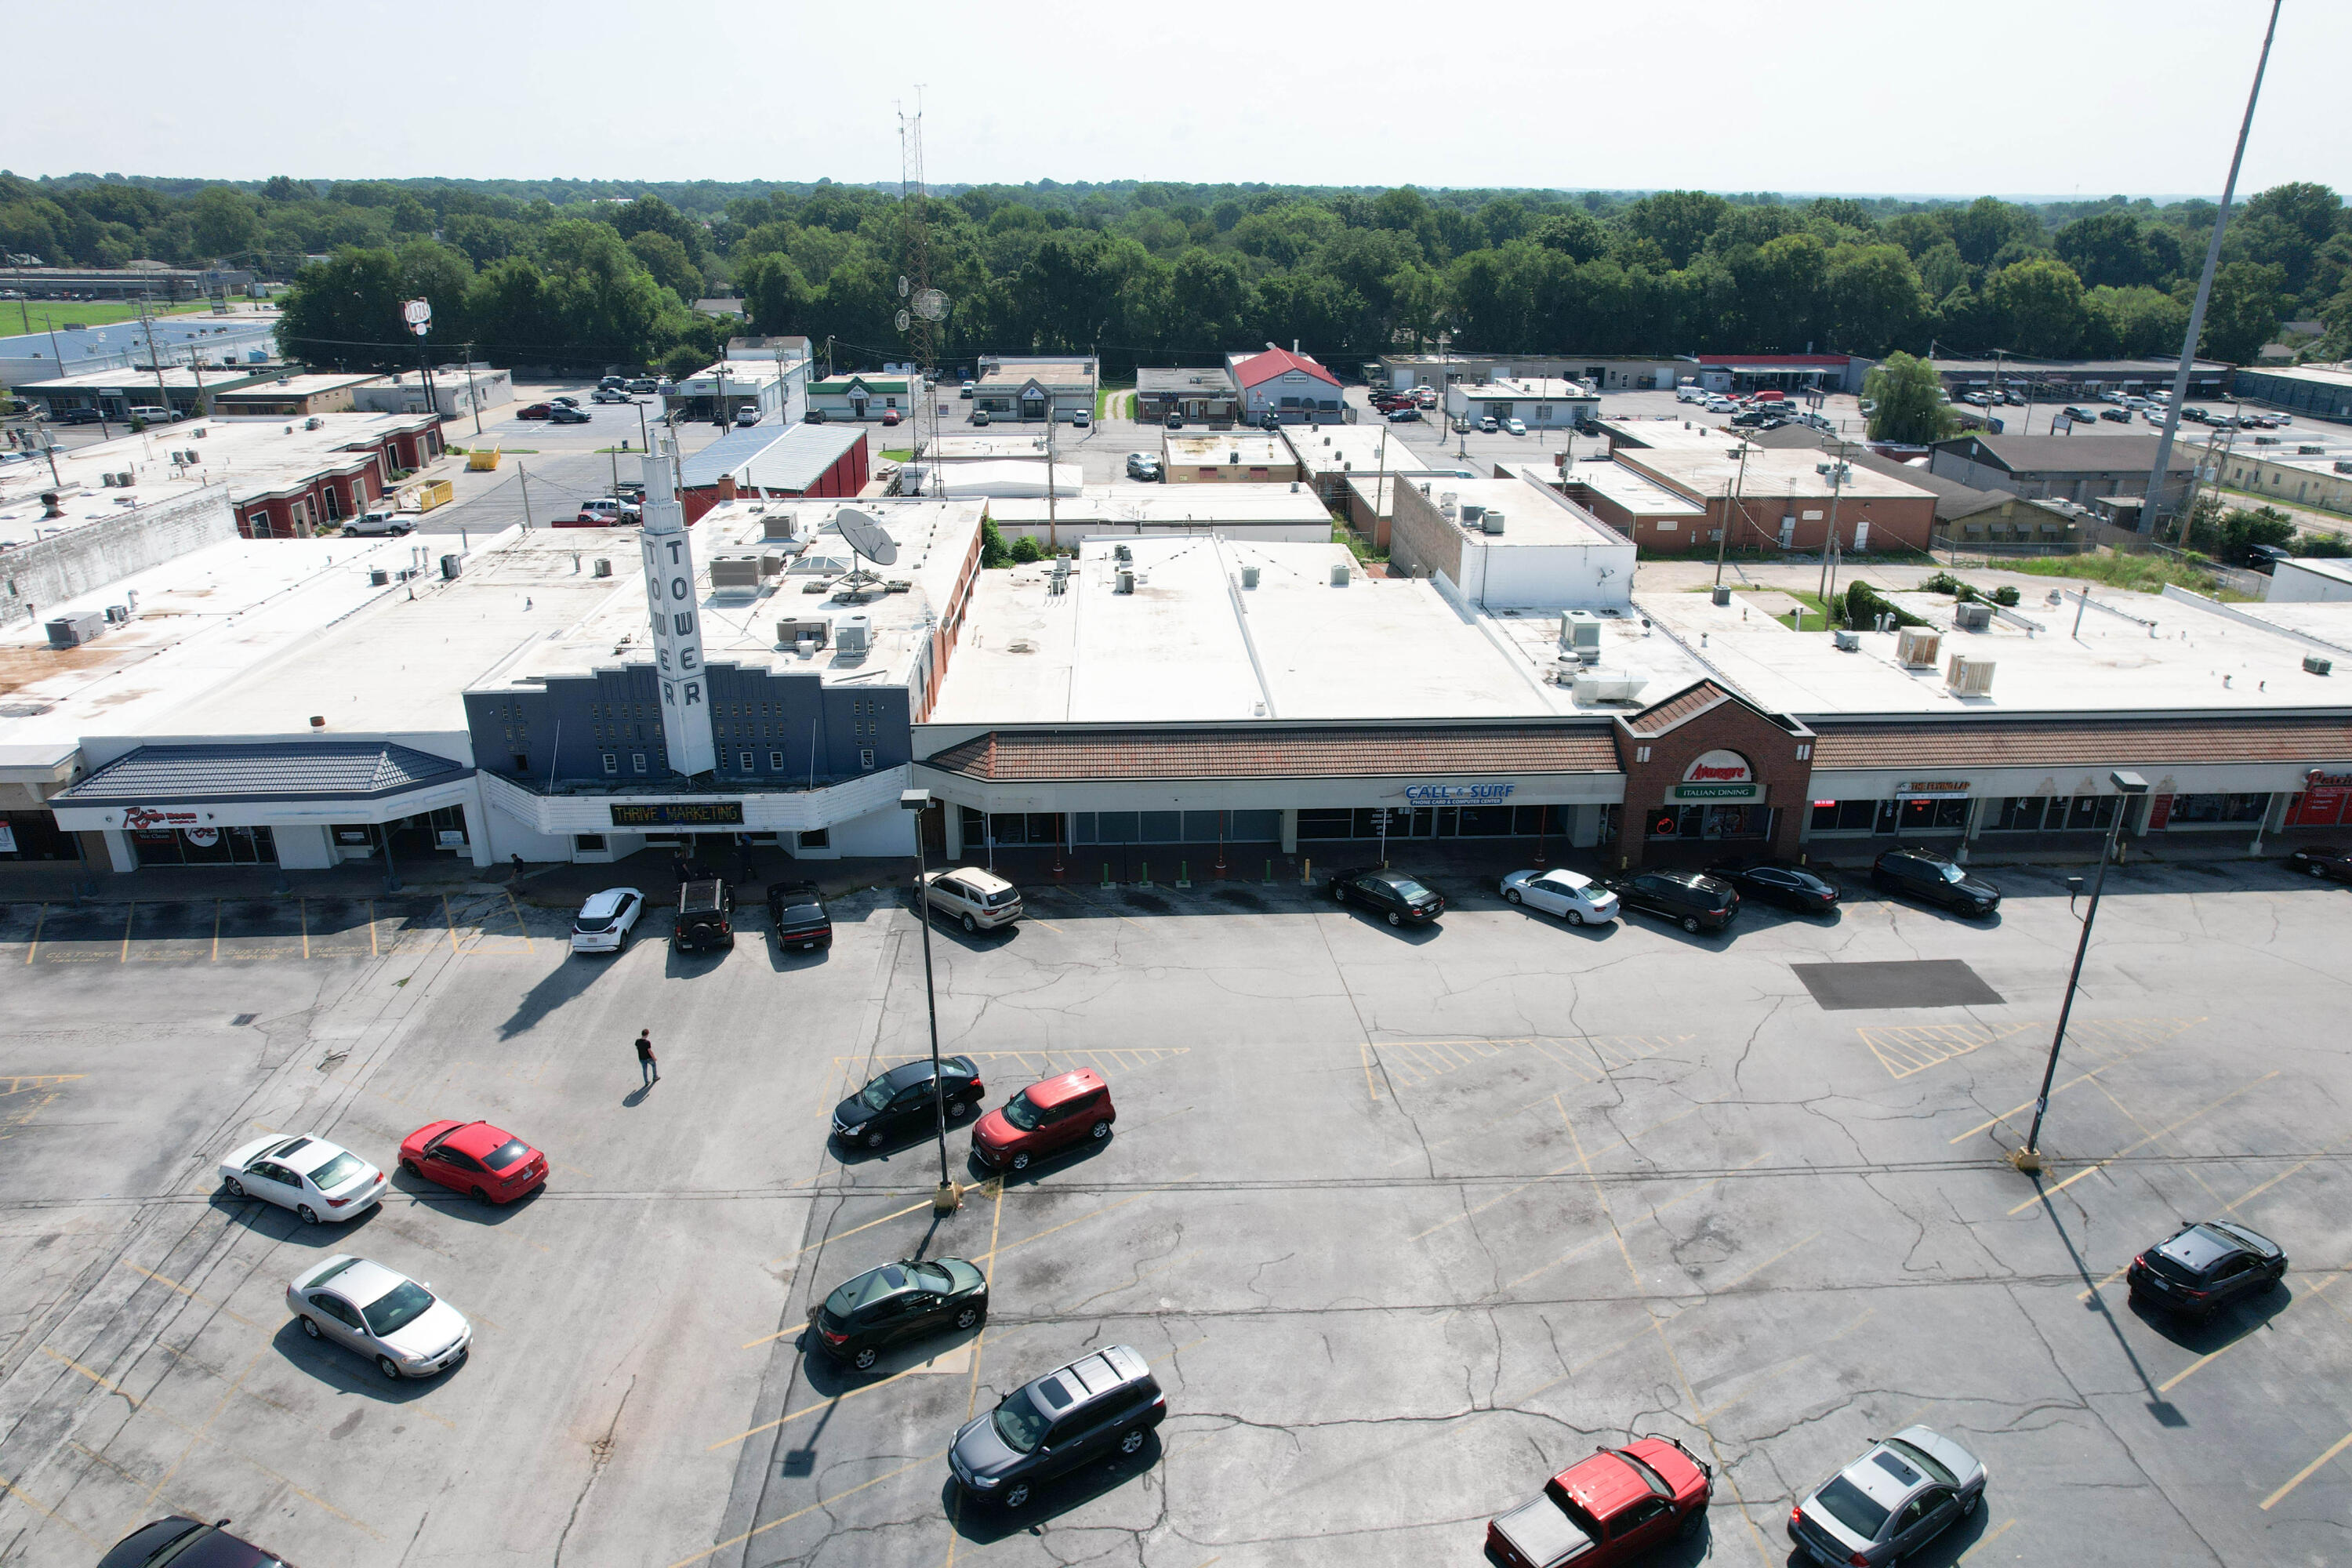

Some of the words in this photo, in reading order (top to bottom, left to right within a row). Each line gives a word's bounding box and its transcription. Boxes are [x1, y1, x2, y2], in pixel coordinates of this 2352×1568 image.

[407, 304, 431, 322] PLAZA
[646, 541, 675, 706] TOWER
[666, 539, 702, 706] TOWER
[1406, 784, 1450, 799] CALL
[1456, 786, 1465, 797] &
[1470, 784, 1515, 798] SURF
[1911, 782, 1926, 791] THE
[615, 807, 659, 822] THRIVE
[666, 805, 737, 821] MARKETING
